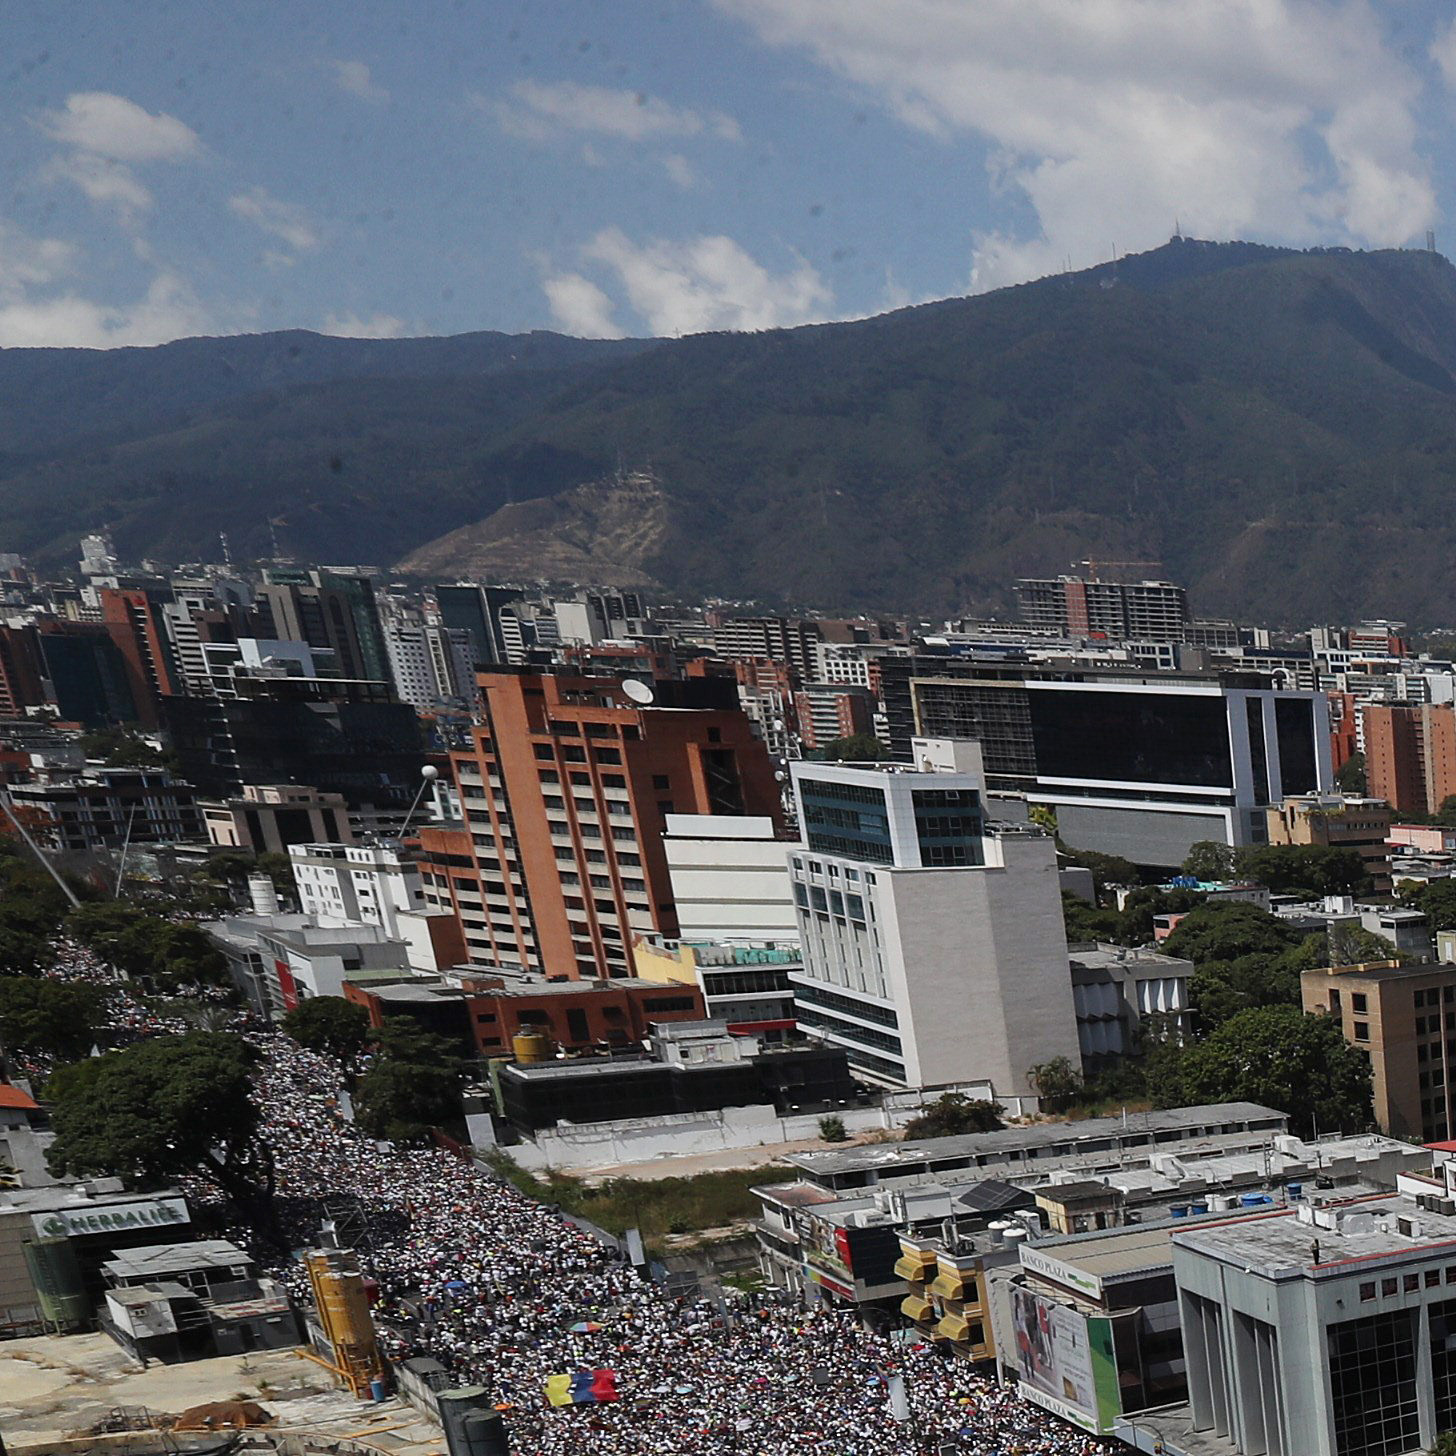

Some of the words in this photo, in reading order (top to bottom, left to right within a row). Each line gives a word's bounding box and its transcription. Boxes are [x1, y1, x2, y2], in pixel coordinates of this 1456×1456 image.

[70, 1206, 182, 1231] HERBALIFE
[1021, 1252, 1044, 1270] BANCO
[1045, 1262, 1067, 1280] PLAZA
[1021, 1384, 1044, 1404] BANCO
[1044, 1397, 1067, 1417] PLAZA
